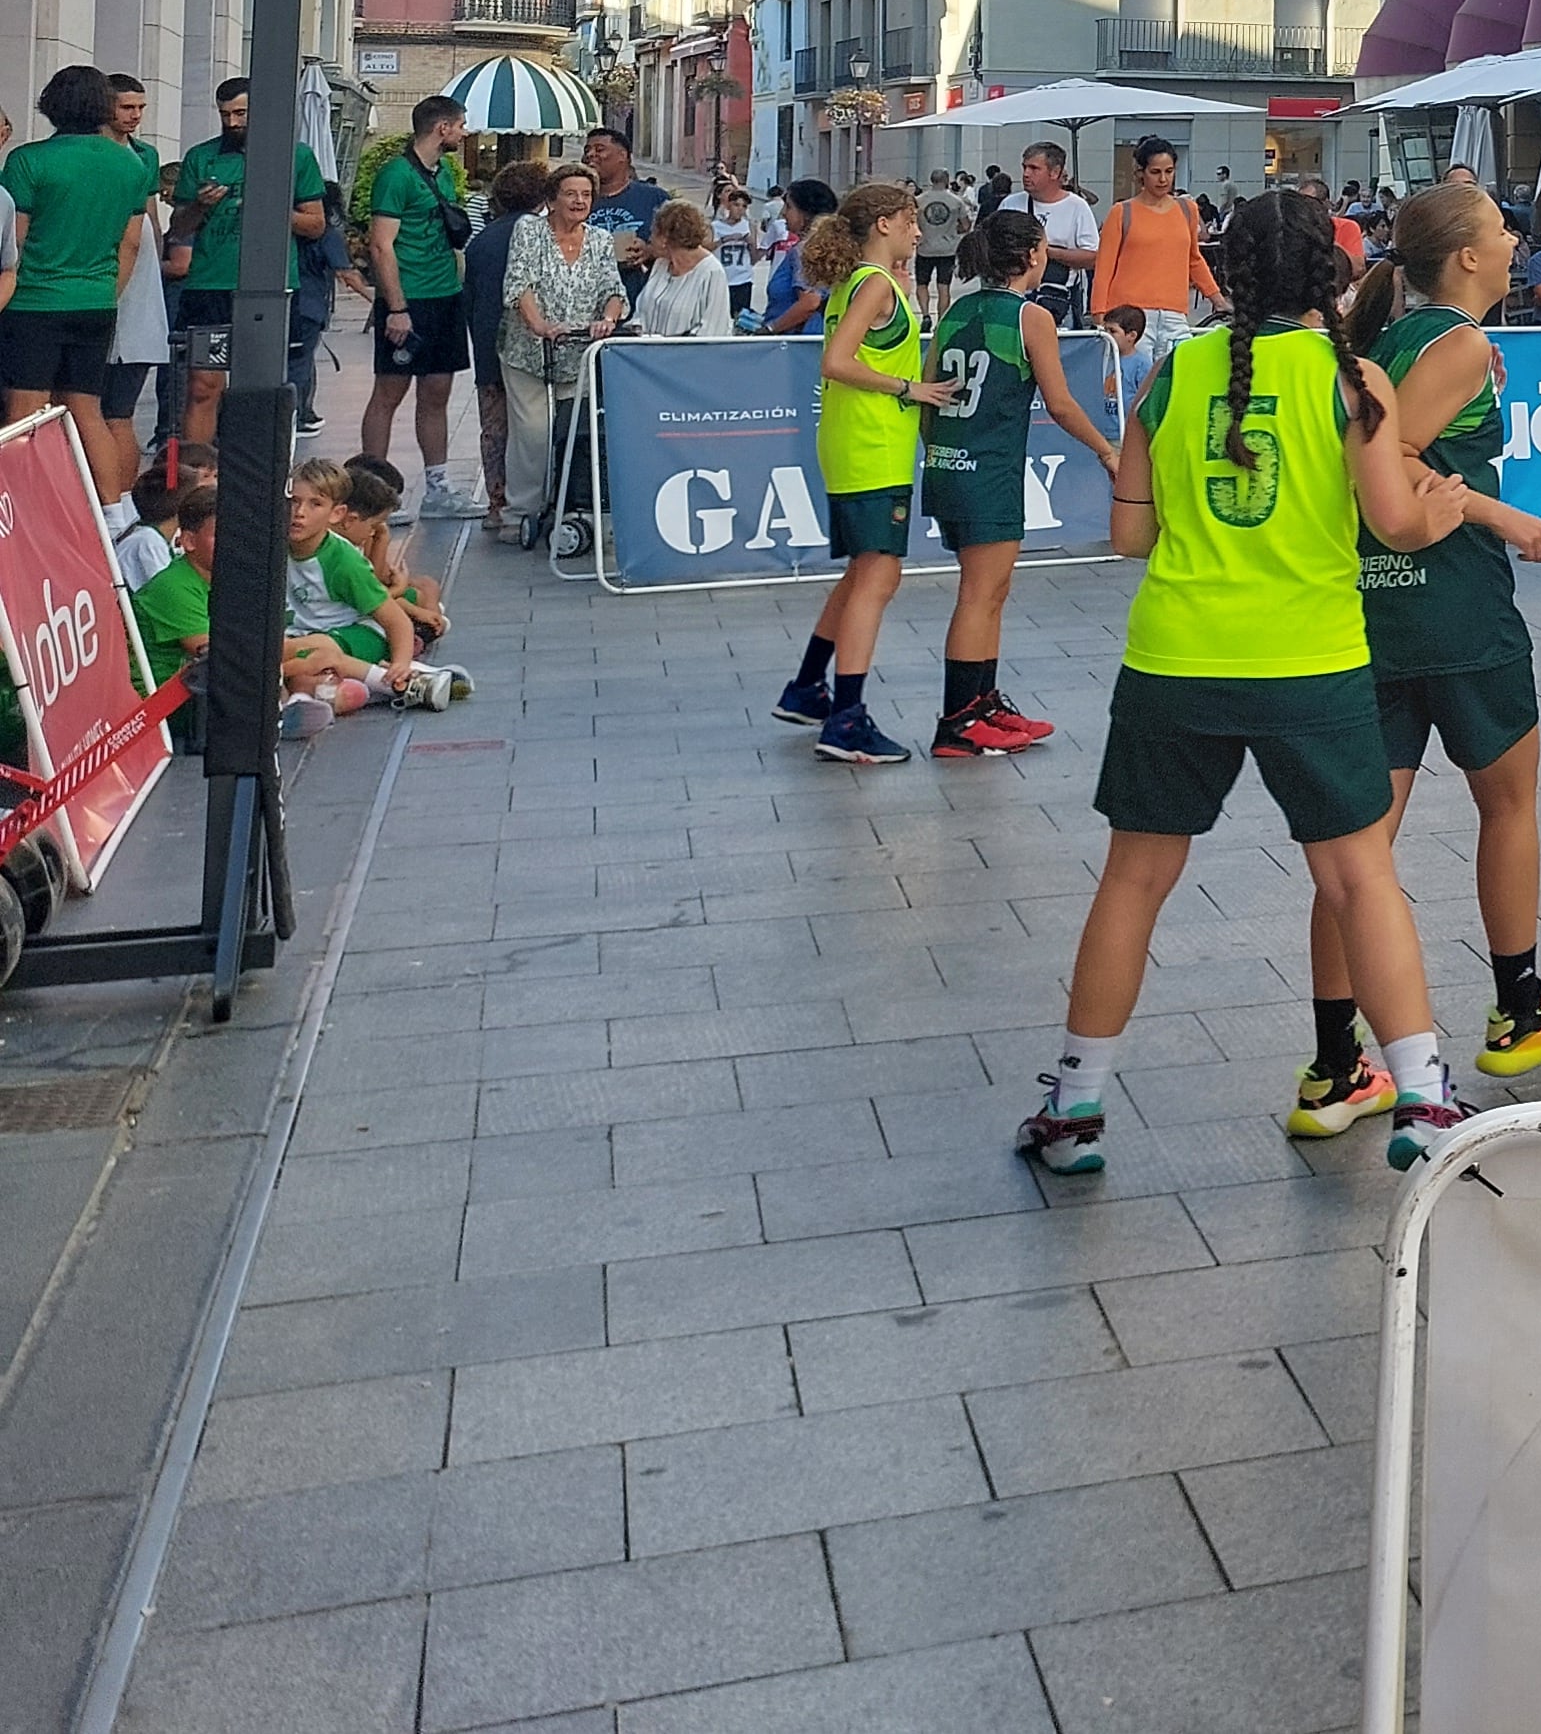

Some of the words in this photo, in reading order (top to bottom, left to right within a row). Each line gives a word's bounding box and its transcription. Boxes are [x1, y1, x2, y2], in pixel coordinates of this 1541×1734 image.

[720, 244, 744, 266] 67
[938, 348, 990, 418] 23
[658, 405, 798, 422] CLIMATIZACIÓN
[1206, 396, 1279, 527] 5
